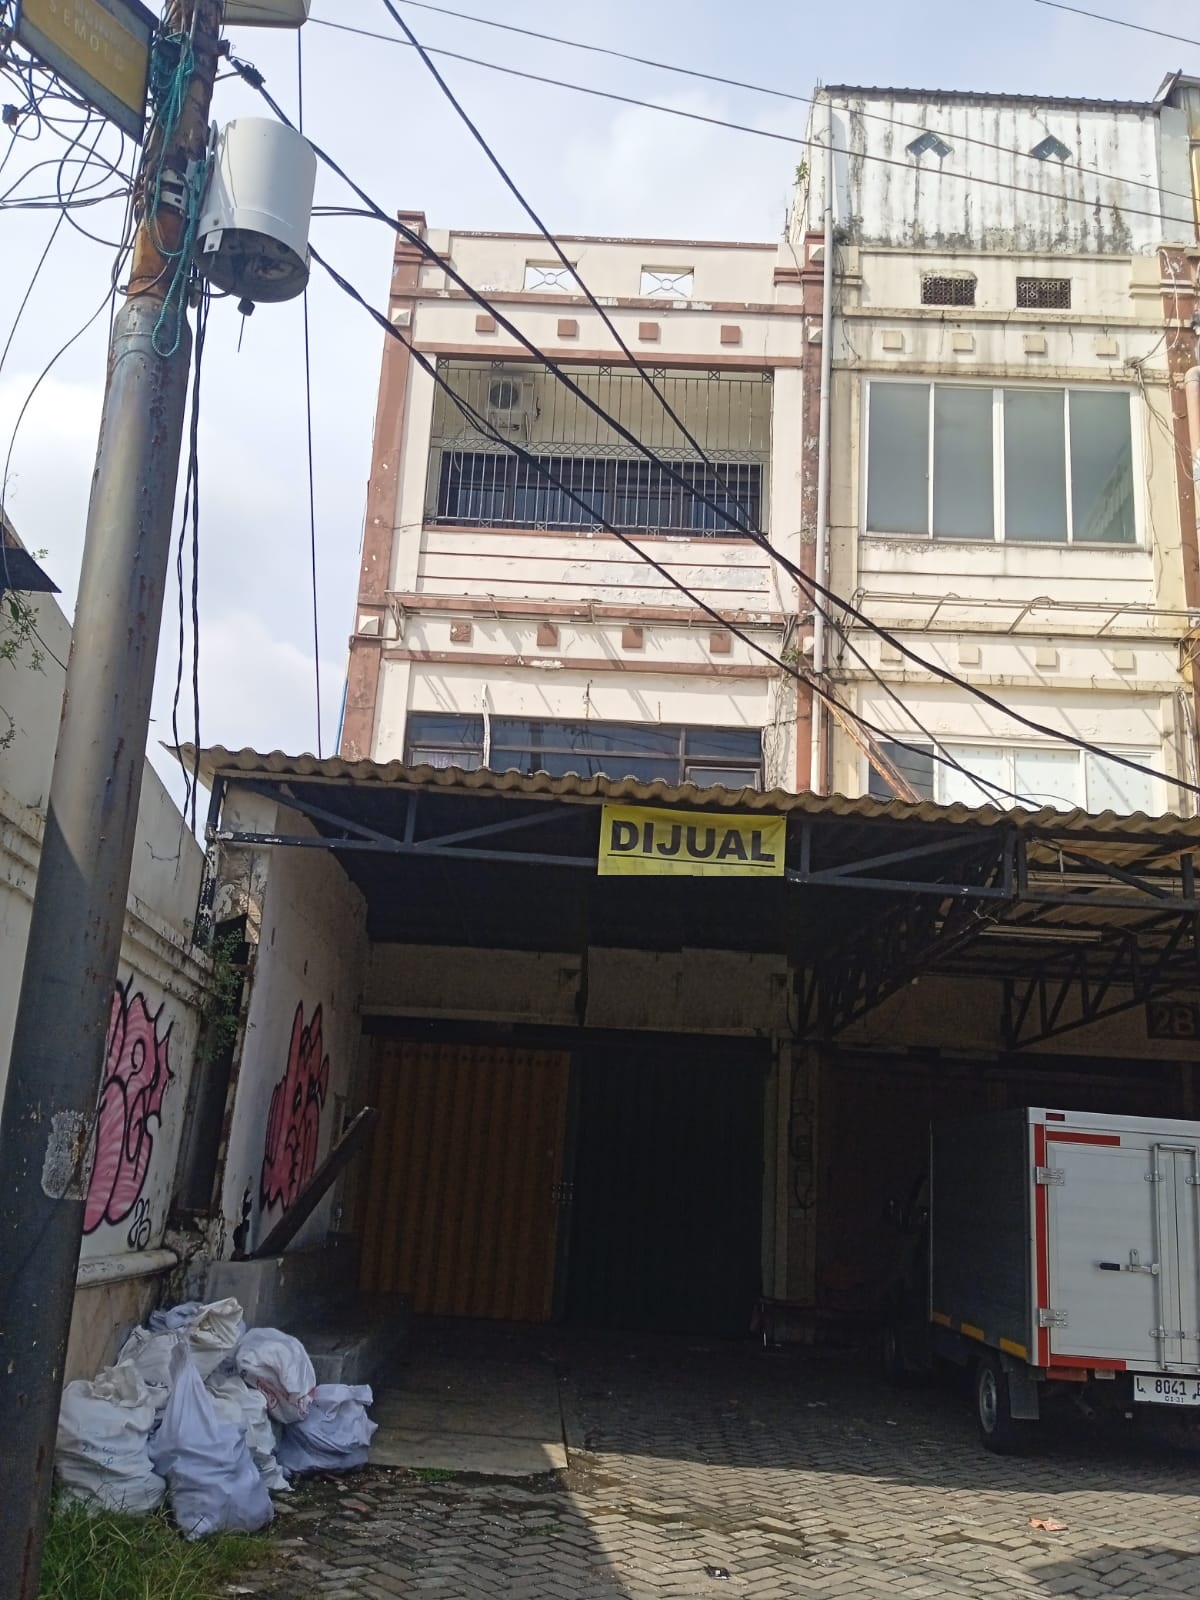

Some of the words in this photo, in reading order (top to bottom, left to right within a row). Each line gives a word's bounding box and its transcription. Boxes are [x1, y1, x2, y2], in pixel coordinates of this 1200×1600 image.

[611, 820, 775, 862] DIJUAL
[1136, 1377, 1146, 1394] L
[1155, 1379, 1186, 1396] 8041
